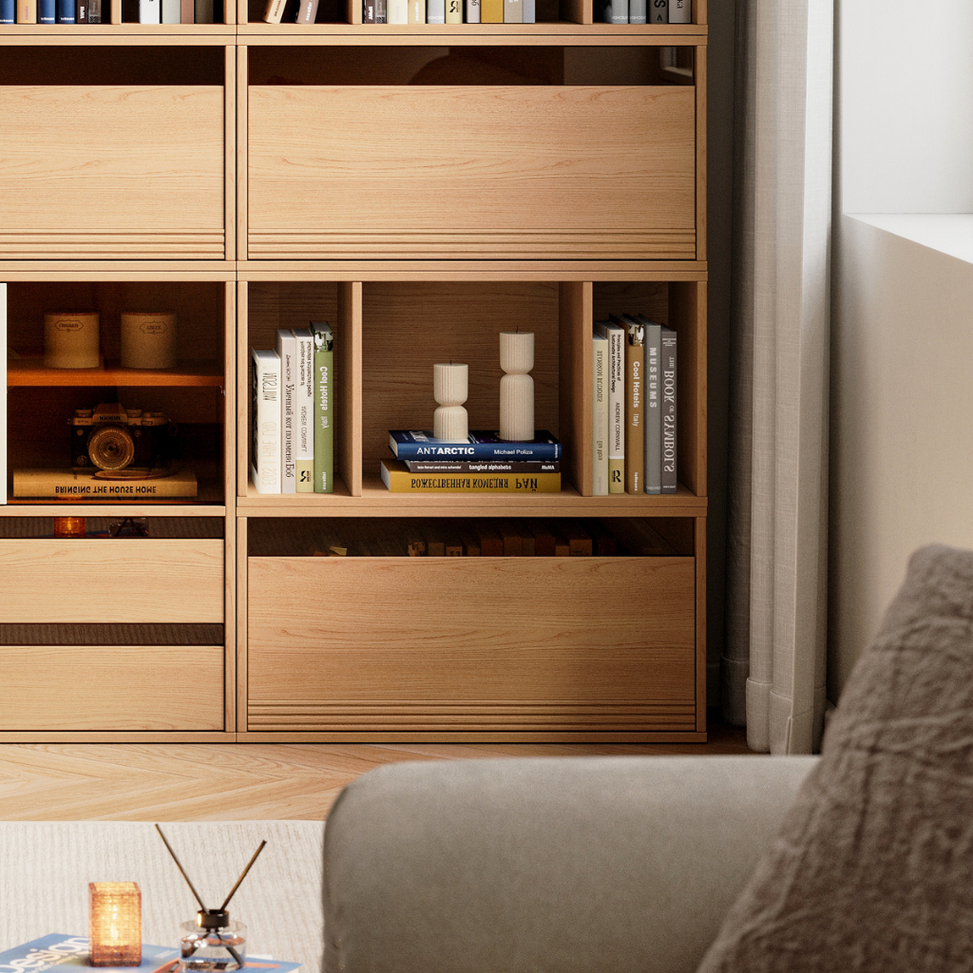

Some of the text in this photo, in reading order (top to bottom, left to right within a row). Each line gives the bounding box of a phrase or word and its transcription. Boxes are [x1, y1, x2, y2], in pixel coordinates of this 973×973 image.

[286, 384, 294, 415] Уличный
[286, 430, 291, 439] по
[417, 447, 475, 455] ANTARCTIC
[286, 464, 294, 478] Боб
